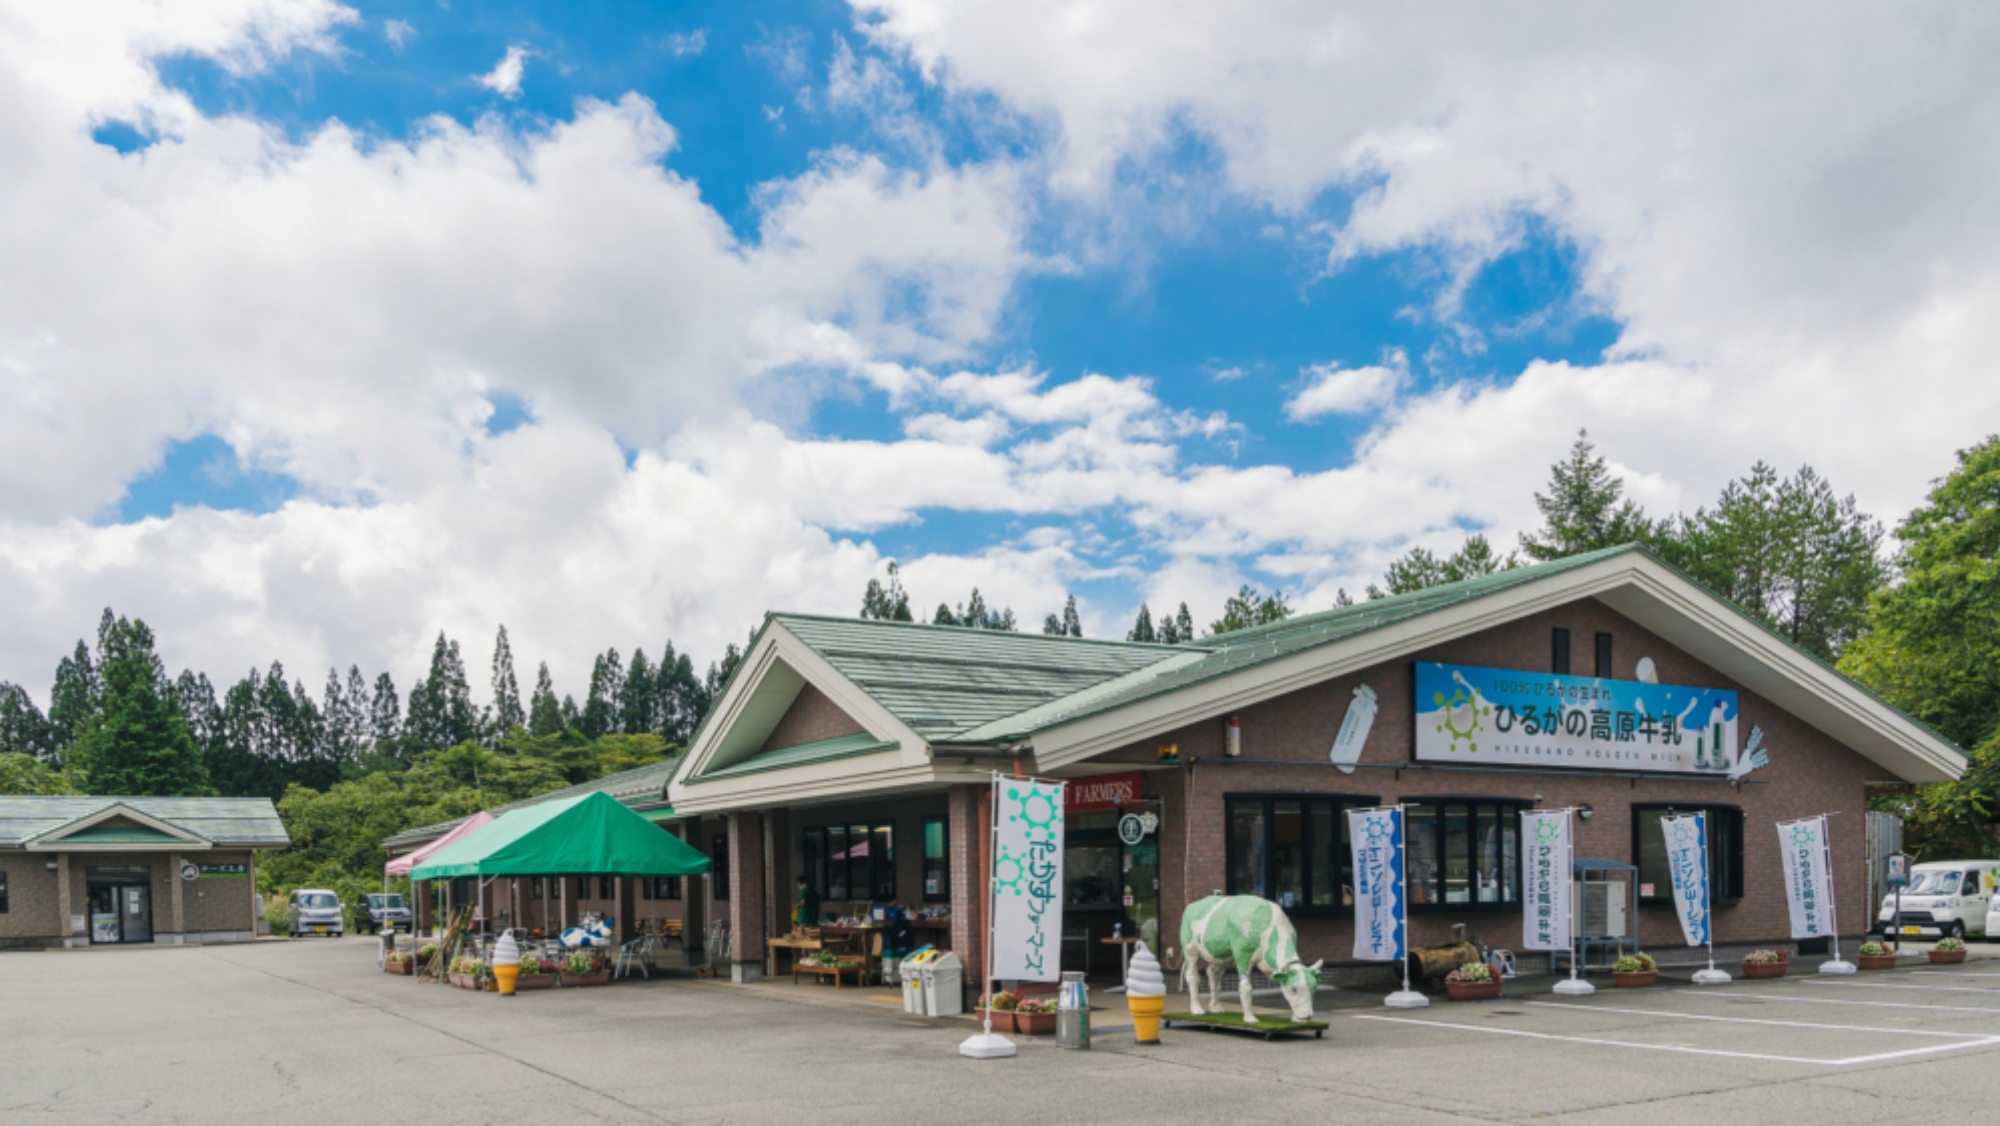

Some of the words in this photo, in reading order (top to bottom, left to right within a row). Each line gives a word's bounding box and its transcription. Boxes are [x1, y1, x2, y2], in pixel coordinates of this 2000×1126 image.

[1493, 679, 1530, 694] 100%
[1533, 683, 1612, 701] ひるがの生まれ
[1494, 704, 1682, 745] ひるがの高原牛乳
[1651, 752, 1682, 763] MILK
[1075, 781, 1133, 804] FARMERS
